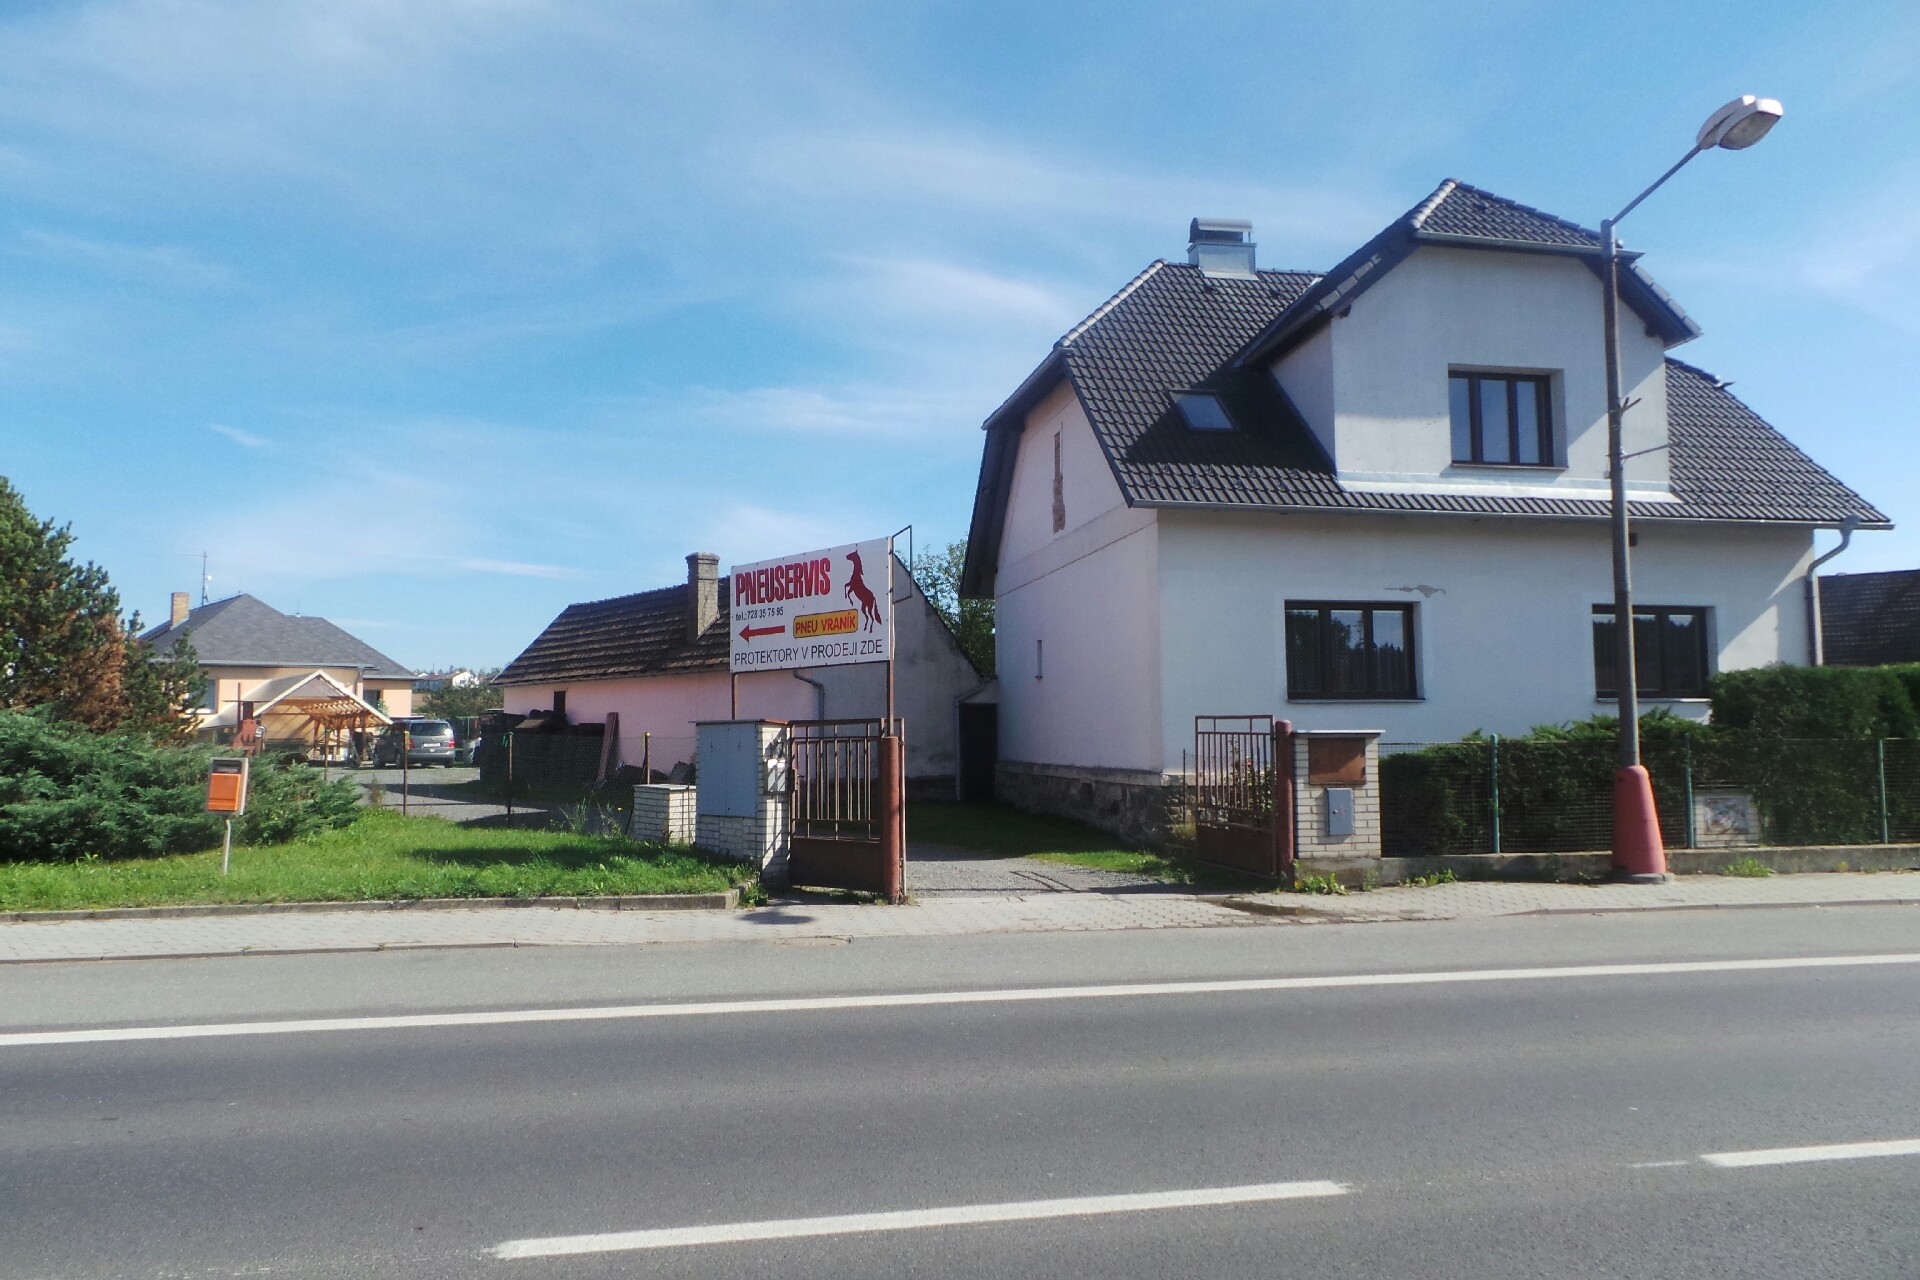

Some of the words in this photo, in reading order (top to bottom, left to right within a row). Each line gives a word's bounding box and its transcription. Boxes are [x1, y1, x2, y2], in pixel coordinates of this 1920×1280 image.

[735, 557, 831, 607] PNEUSERVIS
[795, 620, 818, 635] PNEU
[821, 612, 856, 631] VRANÍK
[734, 647, 799, 666] PROTEKTORY
[801, 646, 809, 660] V
[811, 641, 858, 660] PRODEJI
[860, 639, 883, 655] ZDE
